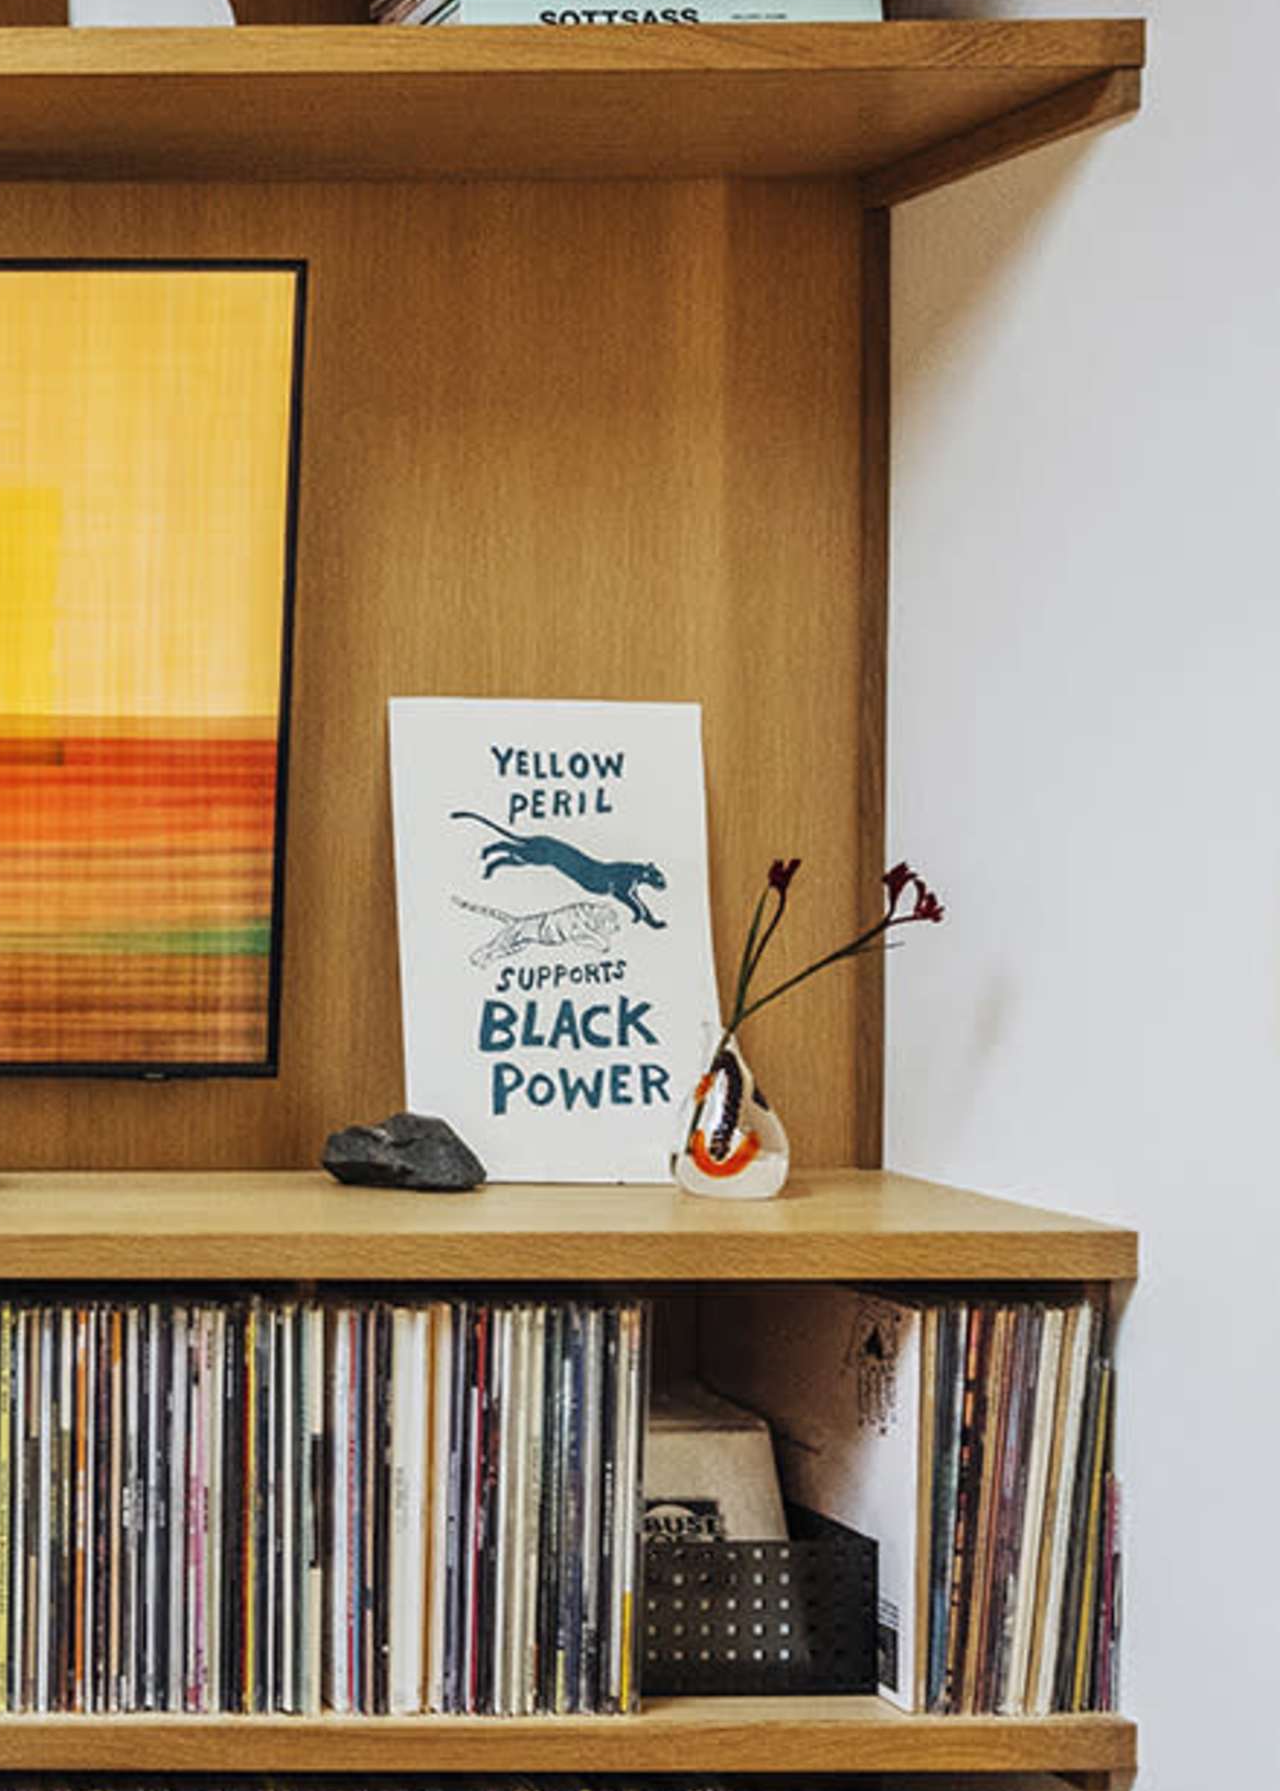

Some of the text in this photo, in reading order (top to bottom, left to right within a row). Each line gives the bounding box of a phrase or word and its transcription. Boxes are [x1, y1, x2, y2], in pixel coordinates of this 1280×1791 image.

[491, 746, 625, 780] YELLOW
[508, 787, 613, 823] PERIL
[496, 959, 628, 993] SUPPORTS
[478, 995, 659, 1053] BLACK
[492, 1062, 671, 1116] POWER
